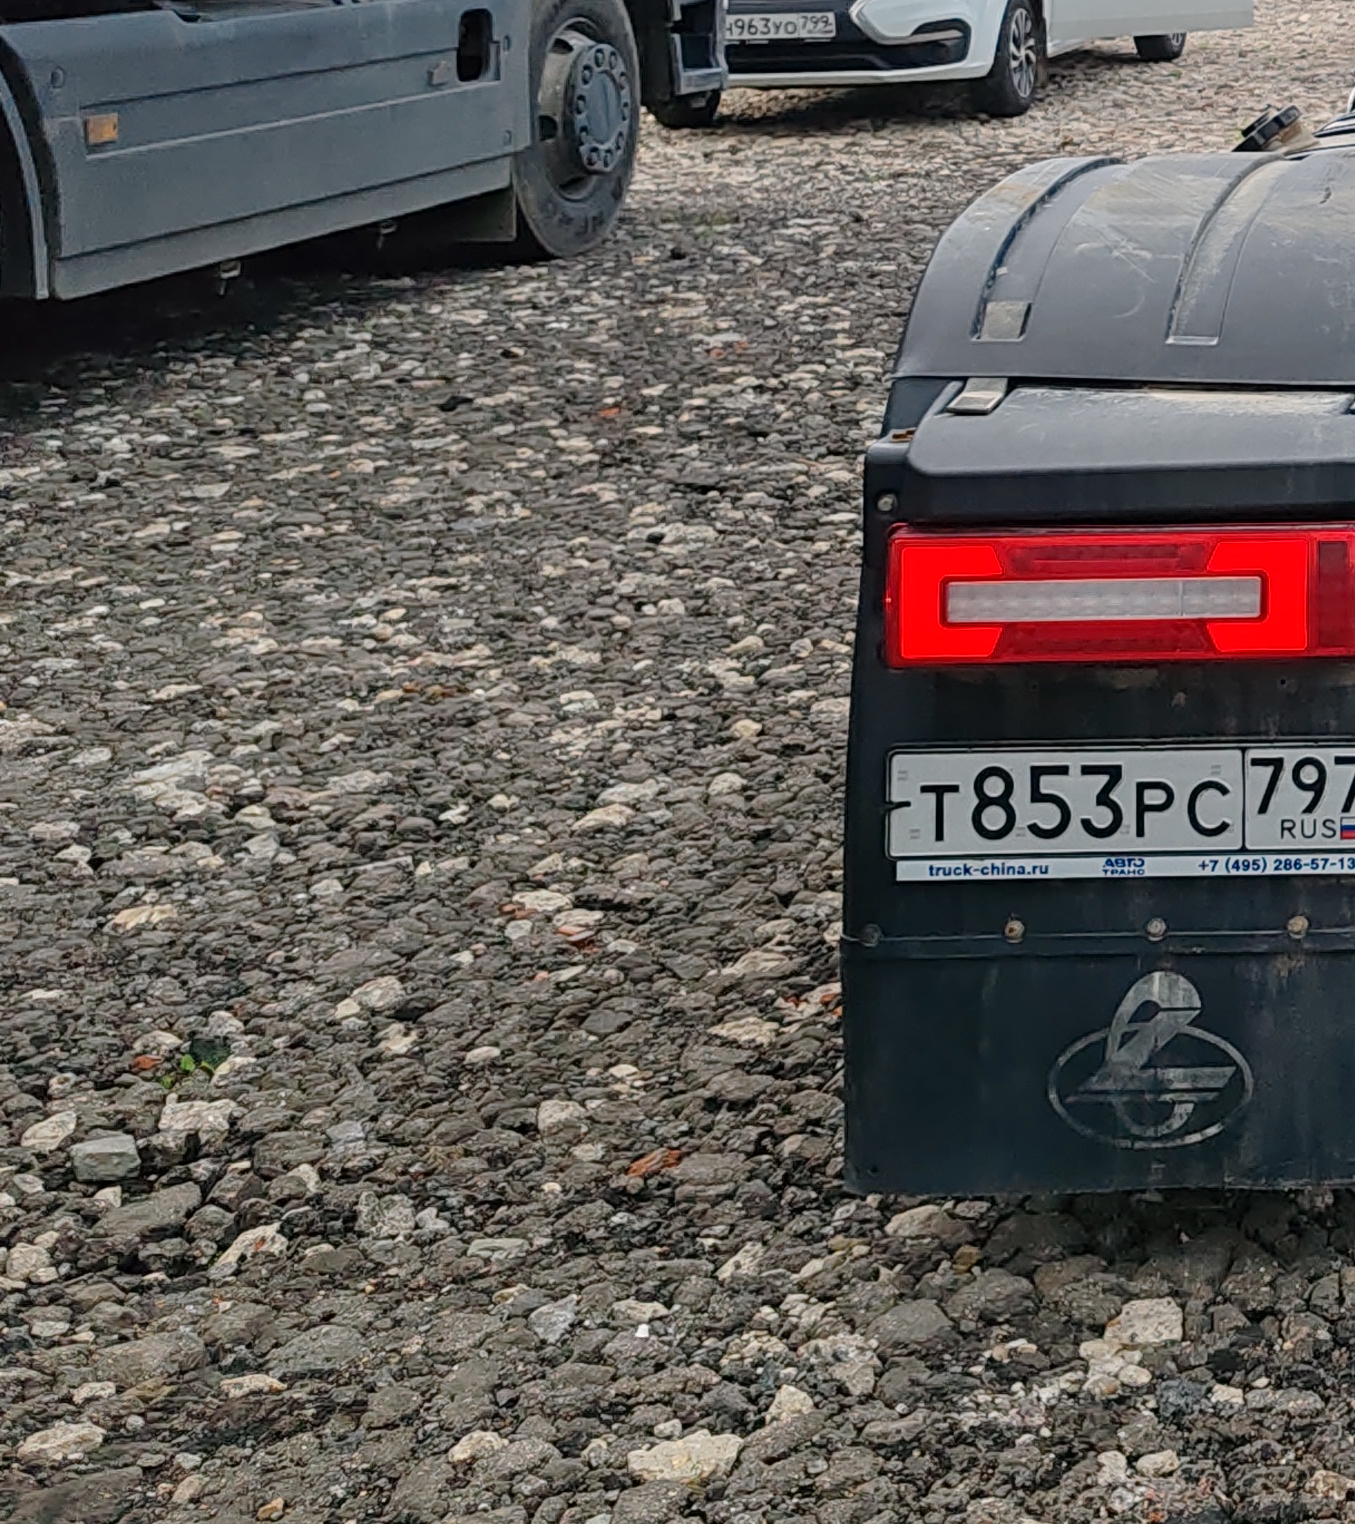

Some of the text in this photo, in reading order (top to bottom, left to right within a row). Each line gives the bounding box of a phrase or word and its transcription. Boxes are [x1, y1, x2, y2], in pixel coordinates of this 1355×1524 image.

[800, 16, 830, 30] 799
[1280, 818, 1337, 840] RUS
[928, 862, 1050, 877] truck-china.ru
[1198, 859, 1219, 872] +7
[1224, 857, 1268, 873] (495)
